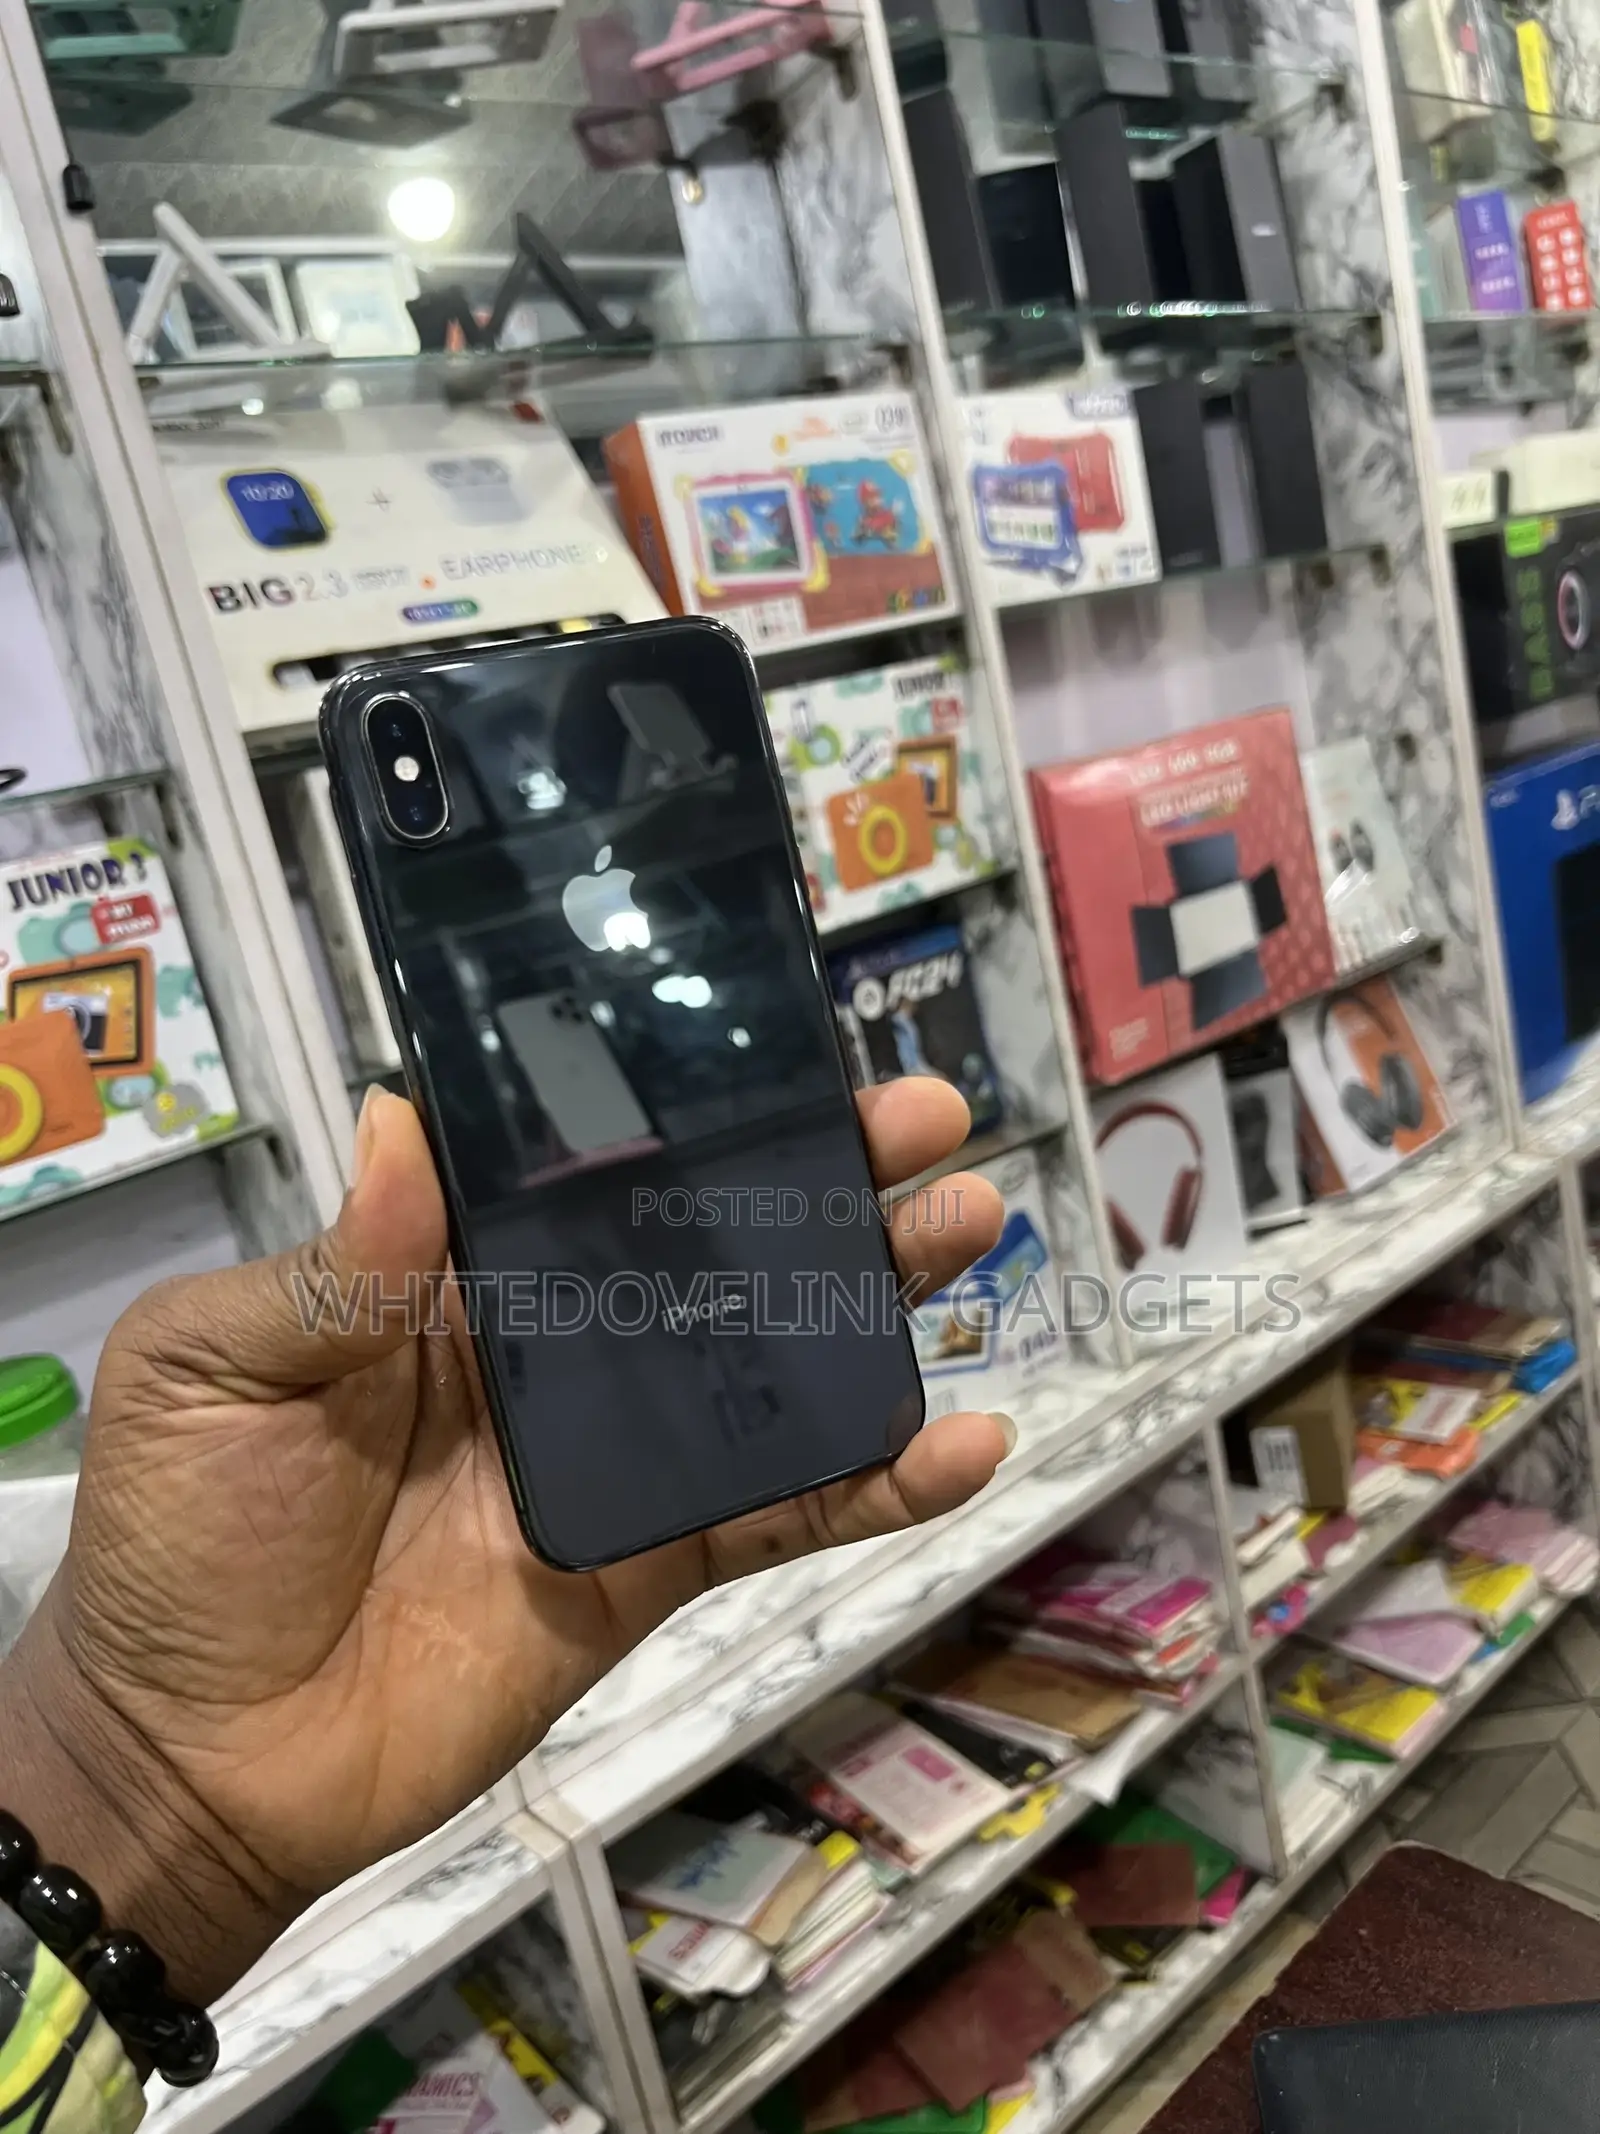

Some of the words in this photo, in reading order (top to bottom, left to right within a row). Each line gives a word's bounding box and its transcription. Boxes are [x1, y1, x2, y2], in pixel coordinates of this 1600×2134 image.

[206, 577, 294, 614] BIG
[299, 569, 349, 600] 2.3
[8, 857, 126, 912] JUNIOR
[661, 1293, 742, 1332] iPhone
